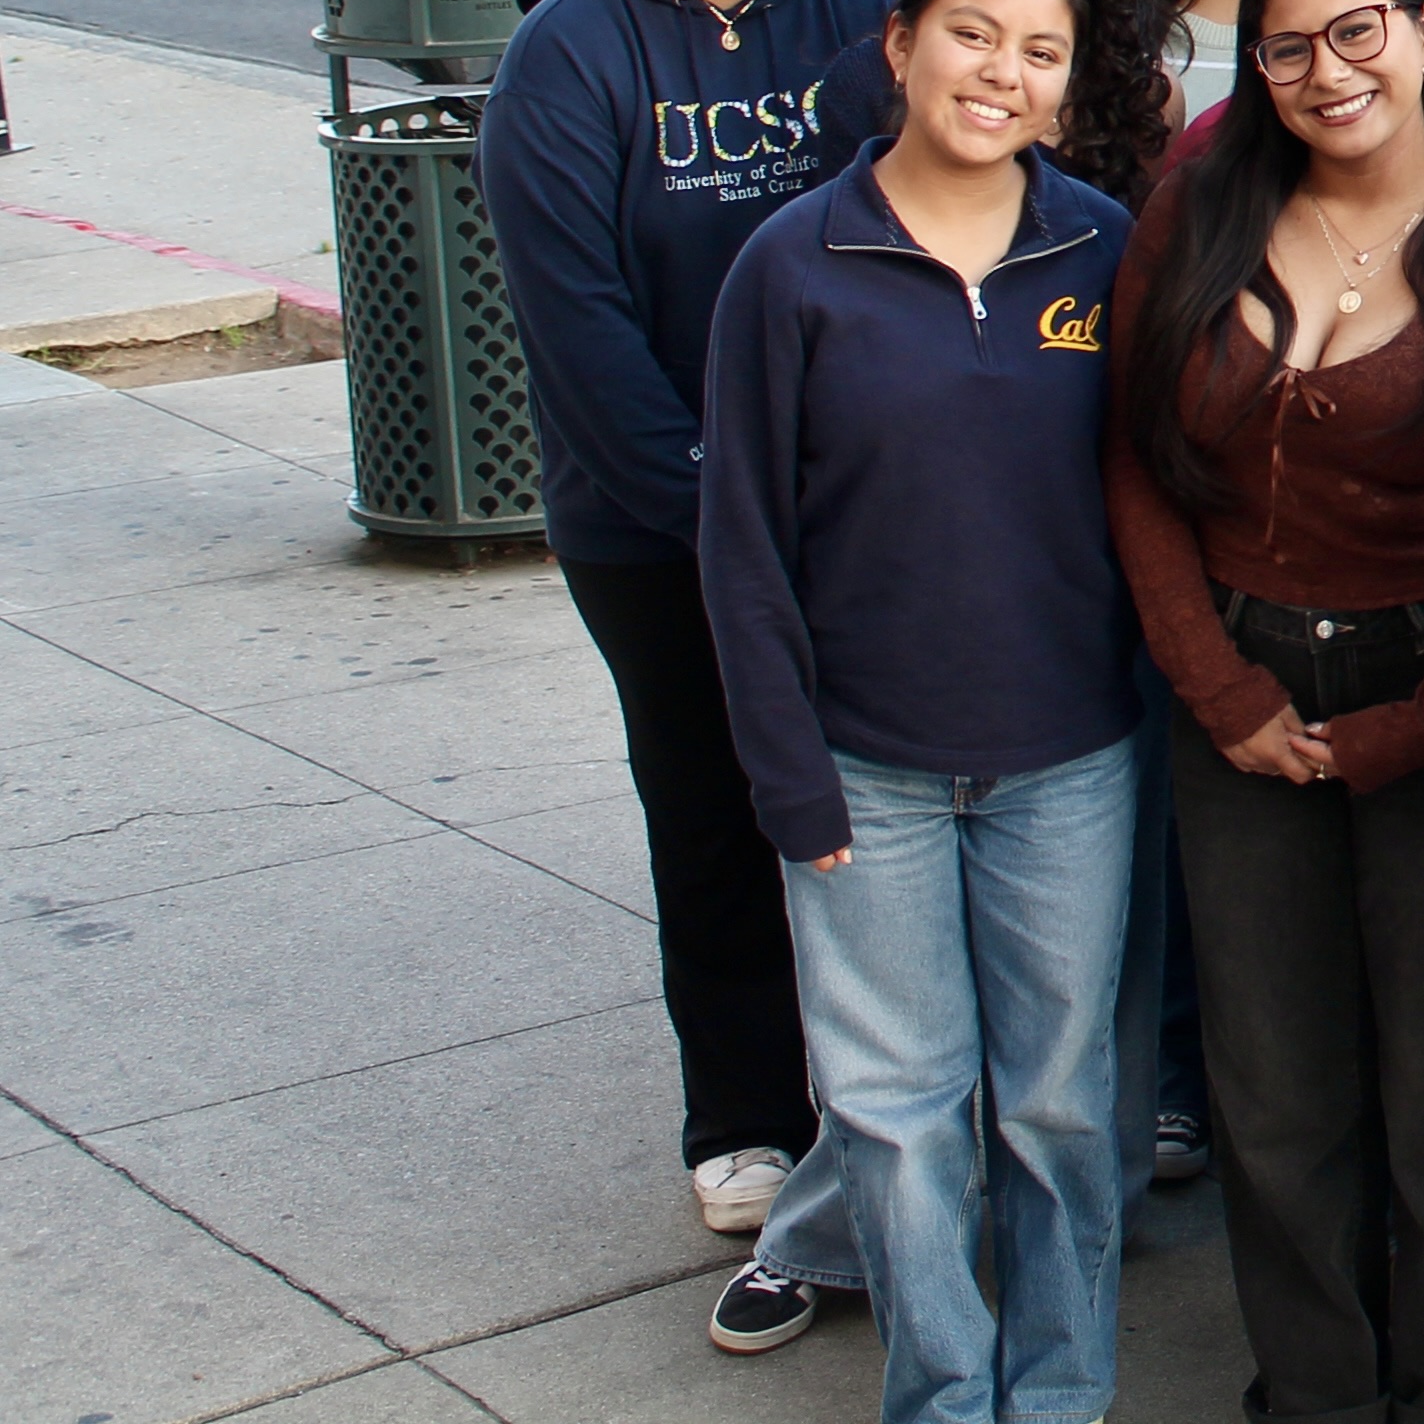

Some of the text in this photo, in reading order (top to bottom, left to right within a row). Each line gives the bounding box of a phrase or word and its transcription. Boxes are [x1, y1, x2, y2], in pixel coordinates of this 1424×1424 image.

[664, 171, 742, 192] University
[750, 166, 767, 181] of
[719, 176, 804, 202] Santa Cruz
[1039, 296, 1101, 352] Cal
